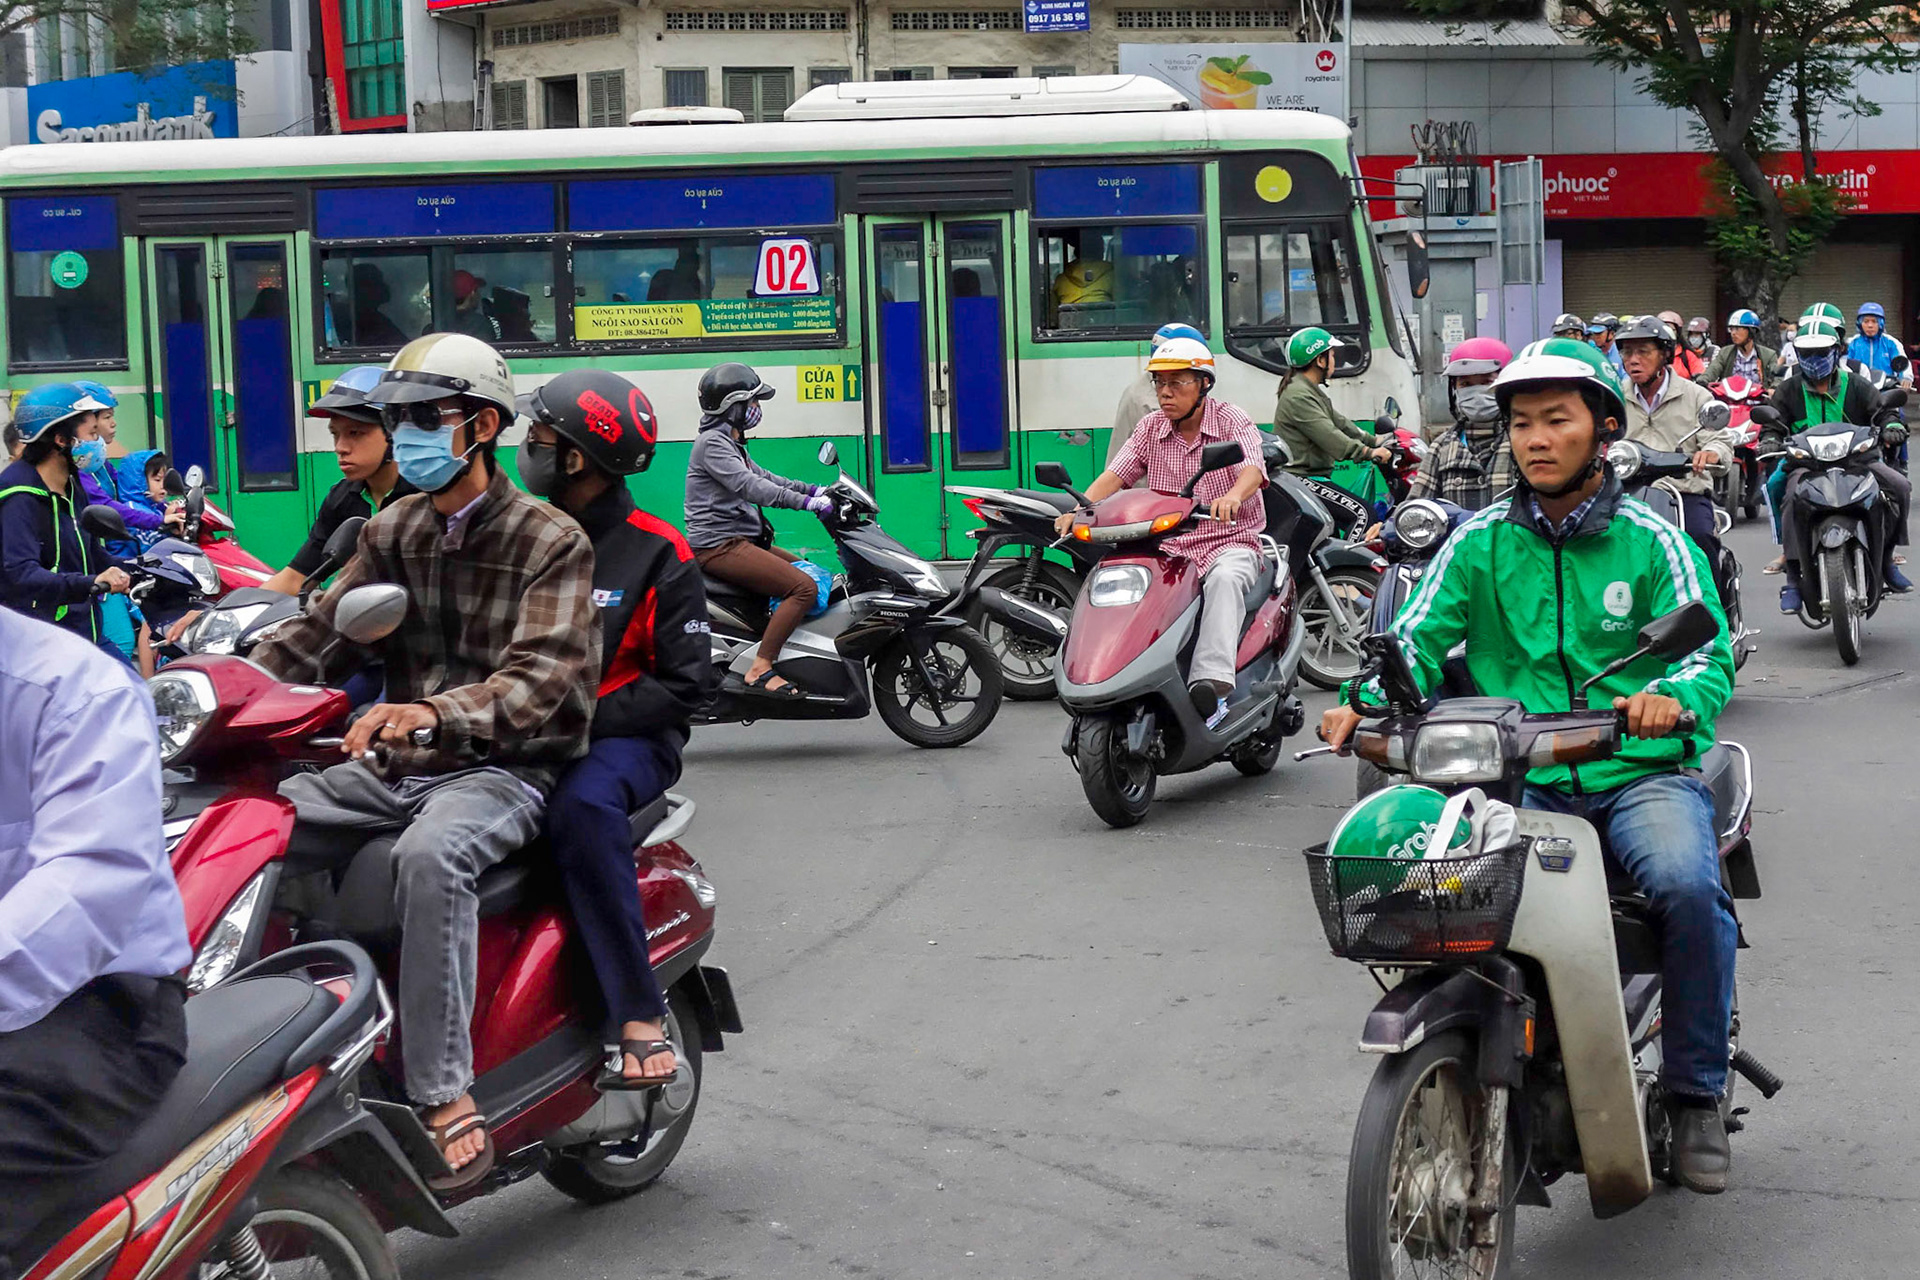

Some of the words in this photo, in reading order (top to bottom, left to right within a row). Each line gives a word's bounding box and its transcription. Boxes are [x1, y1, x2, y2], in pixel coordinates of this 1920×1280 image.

[1028, 14, 1048, 23] 0917
[1051, 13, 1061, 22] 16
[1062, 13, 1073, 21] 36
[1074, 12, 1086, 21] 96
[1266, 95, 1282, 105] WE
[1285, 95, 1305, 105] ARE
[1544, 171, 1610, 201] phuoc
[766, 244, 807, 291] 02
[591, 307, 614, 316] CÔNG
[628, 307, 650, 315] TNHH
[592, 317, 618, 327] NGÔI
[620, 319, 640, 327] SAO
[642, 316, 659, 326] SÀI
[661, 316, 684, 325] GÒN
[1306, 339, 1325, 354] Grab
[804, 367, 835, 383] CỬA
[805, 385, 835, 400] LÊN
[1320, 488, 1340, 501] FILA
[1340, 496, 1358, 510] FILA
[880, 610, 909, 618] HONDA
[1601, 619, 1634, 631] Grab
[1386, 820, 1439, 866] Grab
